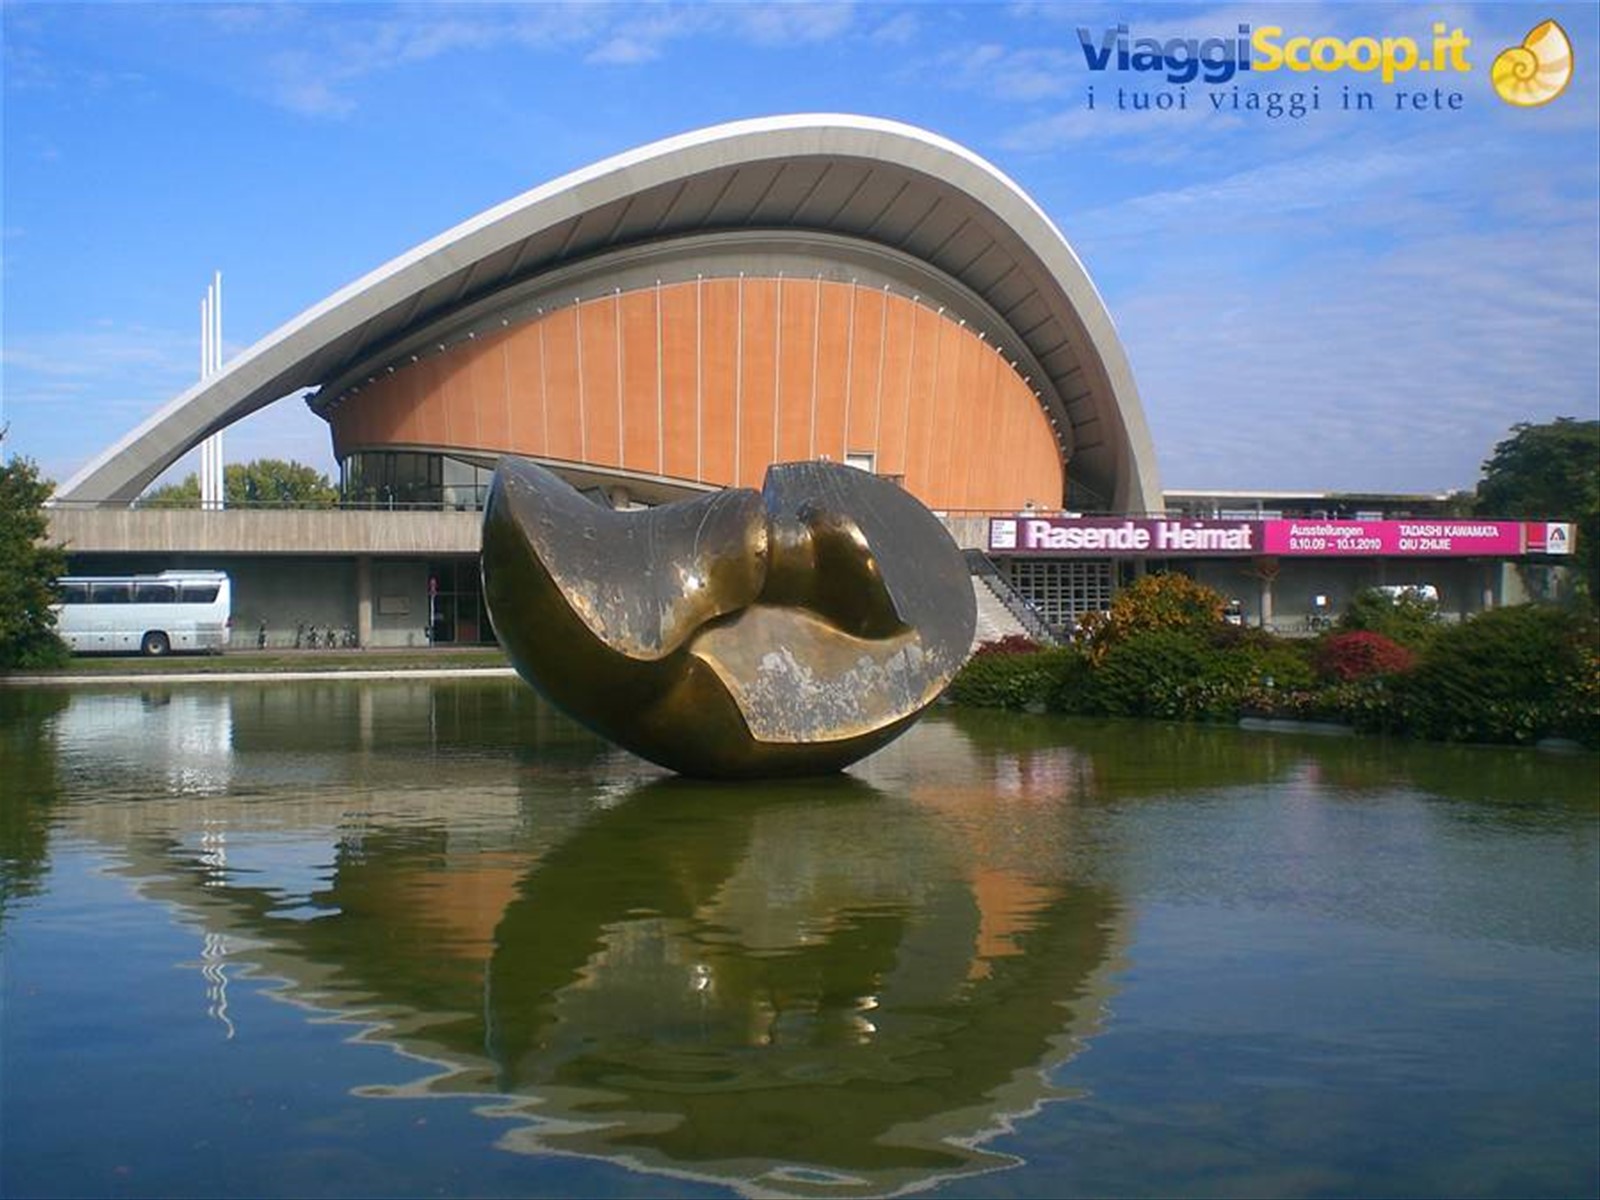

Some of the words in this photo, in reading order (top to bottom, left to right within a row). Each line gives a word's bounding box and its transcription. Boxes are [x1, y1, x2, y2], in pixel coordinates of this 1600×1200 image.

[1025, 520, 1149, 549] Rasende
[1156, 521, 1252, 549] Heimat
[1289, 525, 1364, 538] Ausstellungen
[1399, 524, 1442, 537] TADASHI
[1444, 525, 1499, 537] KAWAMATA
[1289, 538, 1325, 550] 9.10.09
[1336, 538, 1381, 550] 10.1.2010
[1399, 538, 1418, 550] QIU
